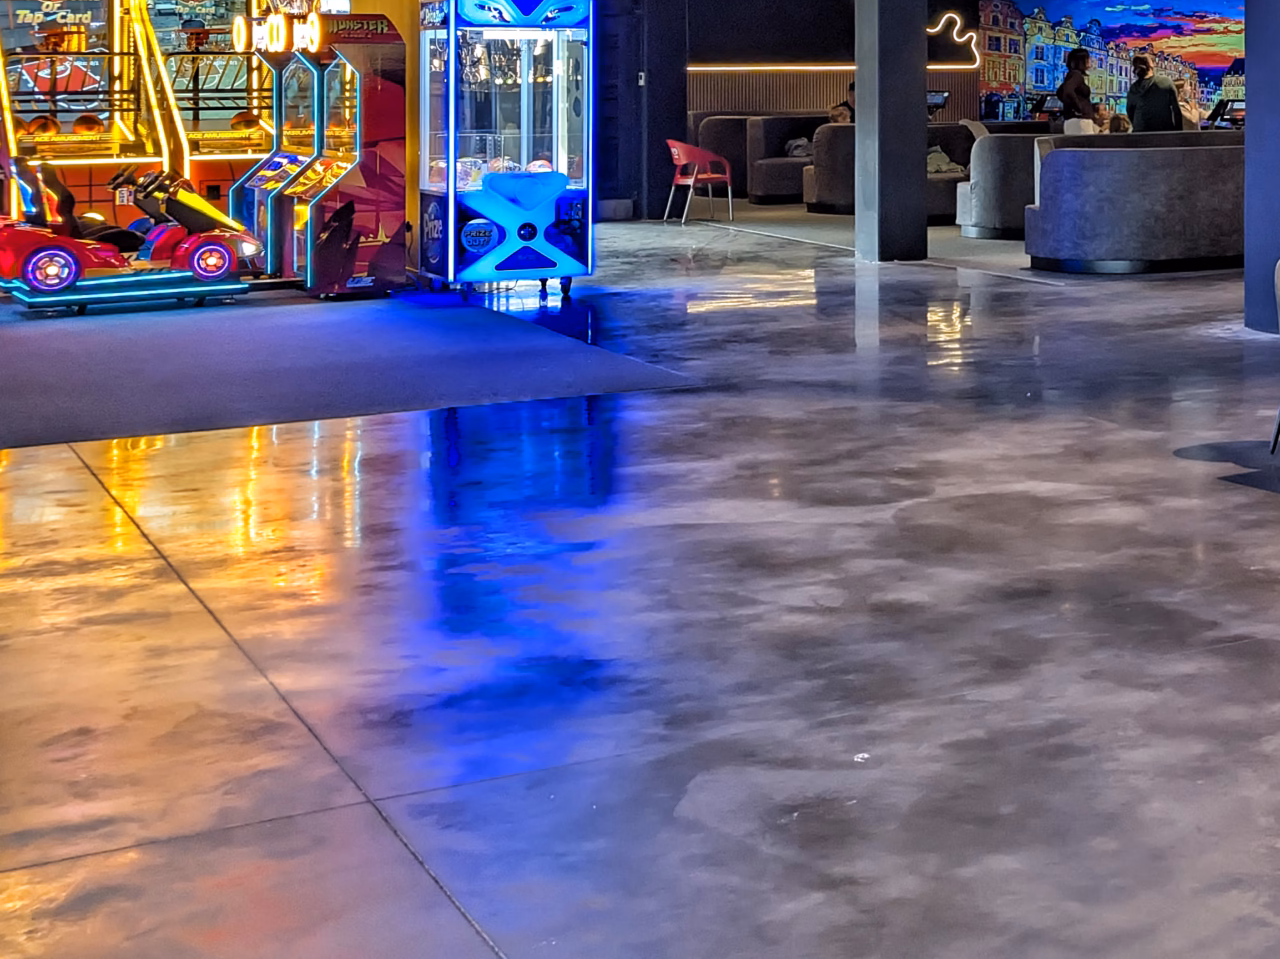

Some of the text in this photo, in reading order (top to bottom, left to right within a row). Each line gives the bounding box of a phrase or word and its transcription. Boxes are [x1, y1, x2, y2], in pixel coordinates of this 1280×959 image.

[16, 10, 92, 25] Tap Card
[422, 213, 443, 240] Prize
[464, 229, 493, 238] PRIZE
